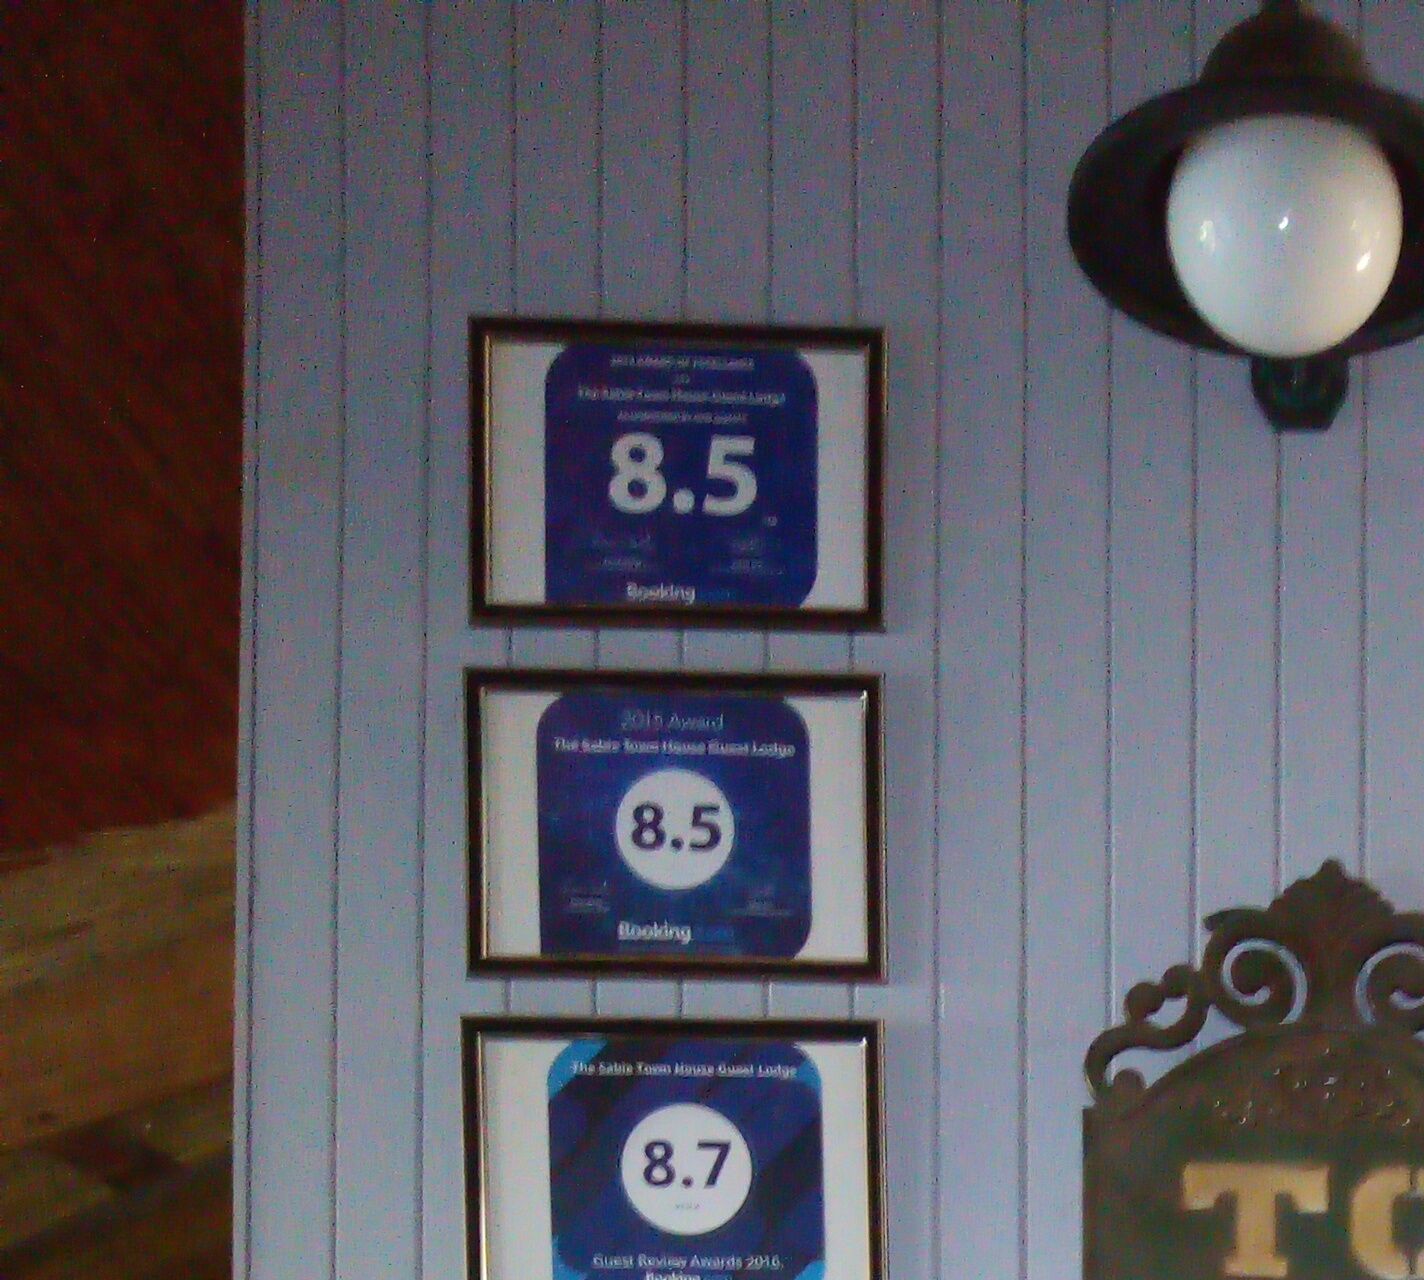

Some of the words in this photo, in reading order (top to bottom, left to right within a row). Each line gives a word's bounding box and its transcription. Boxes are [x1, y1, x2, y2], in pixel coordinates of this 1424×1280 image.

[608, 432, 758, 516] 8.5
[632, 801, 723, 852] 8.5
[571, 1060, 596, 1076] The
[636, 1061, 672, 1077] Town
[643, 1139, 733, 1190] 8.7
[592, 1252, 634, 1270] Guest
[637, 1253, 688, 1271] Review
[689, 1254, 743, 1271] Awards
